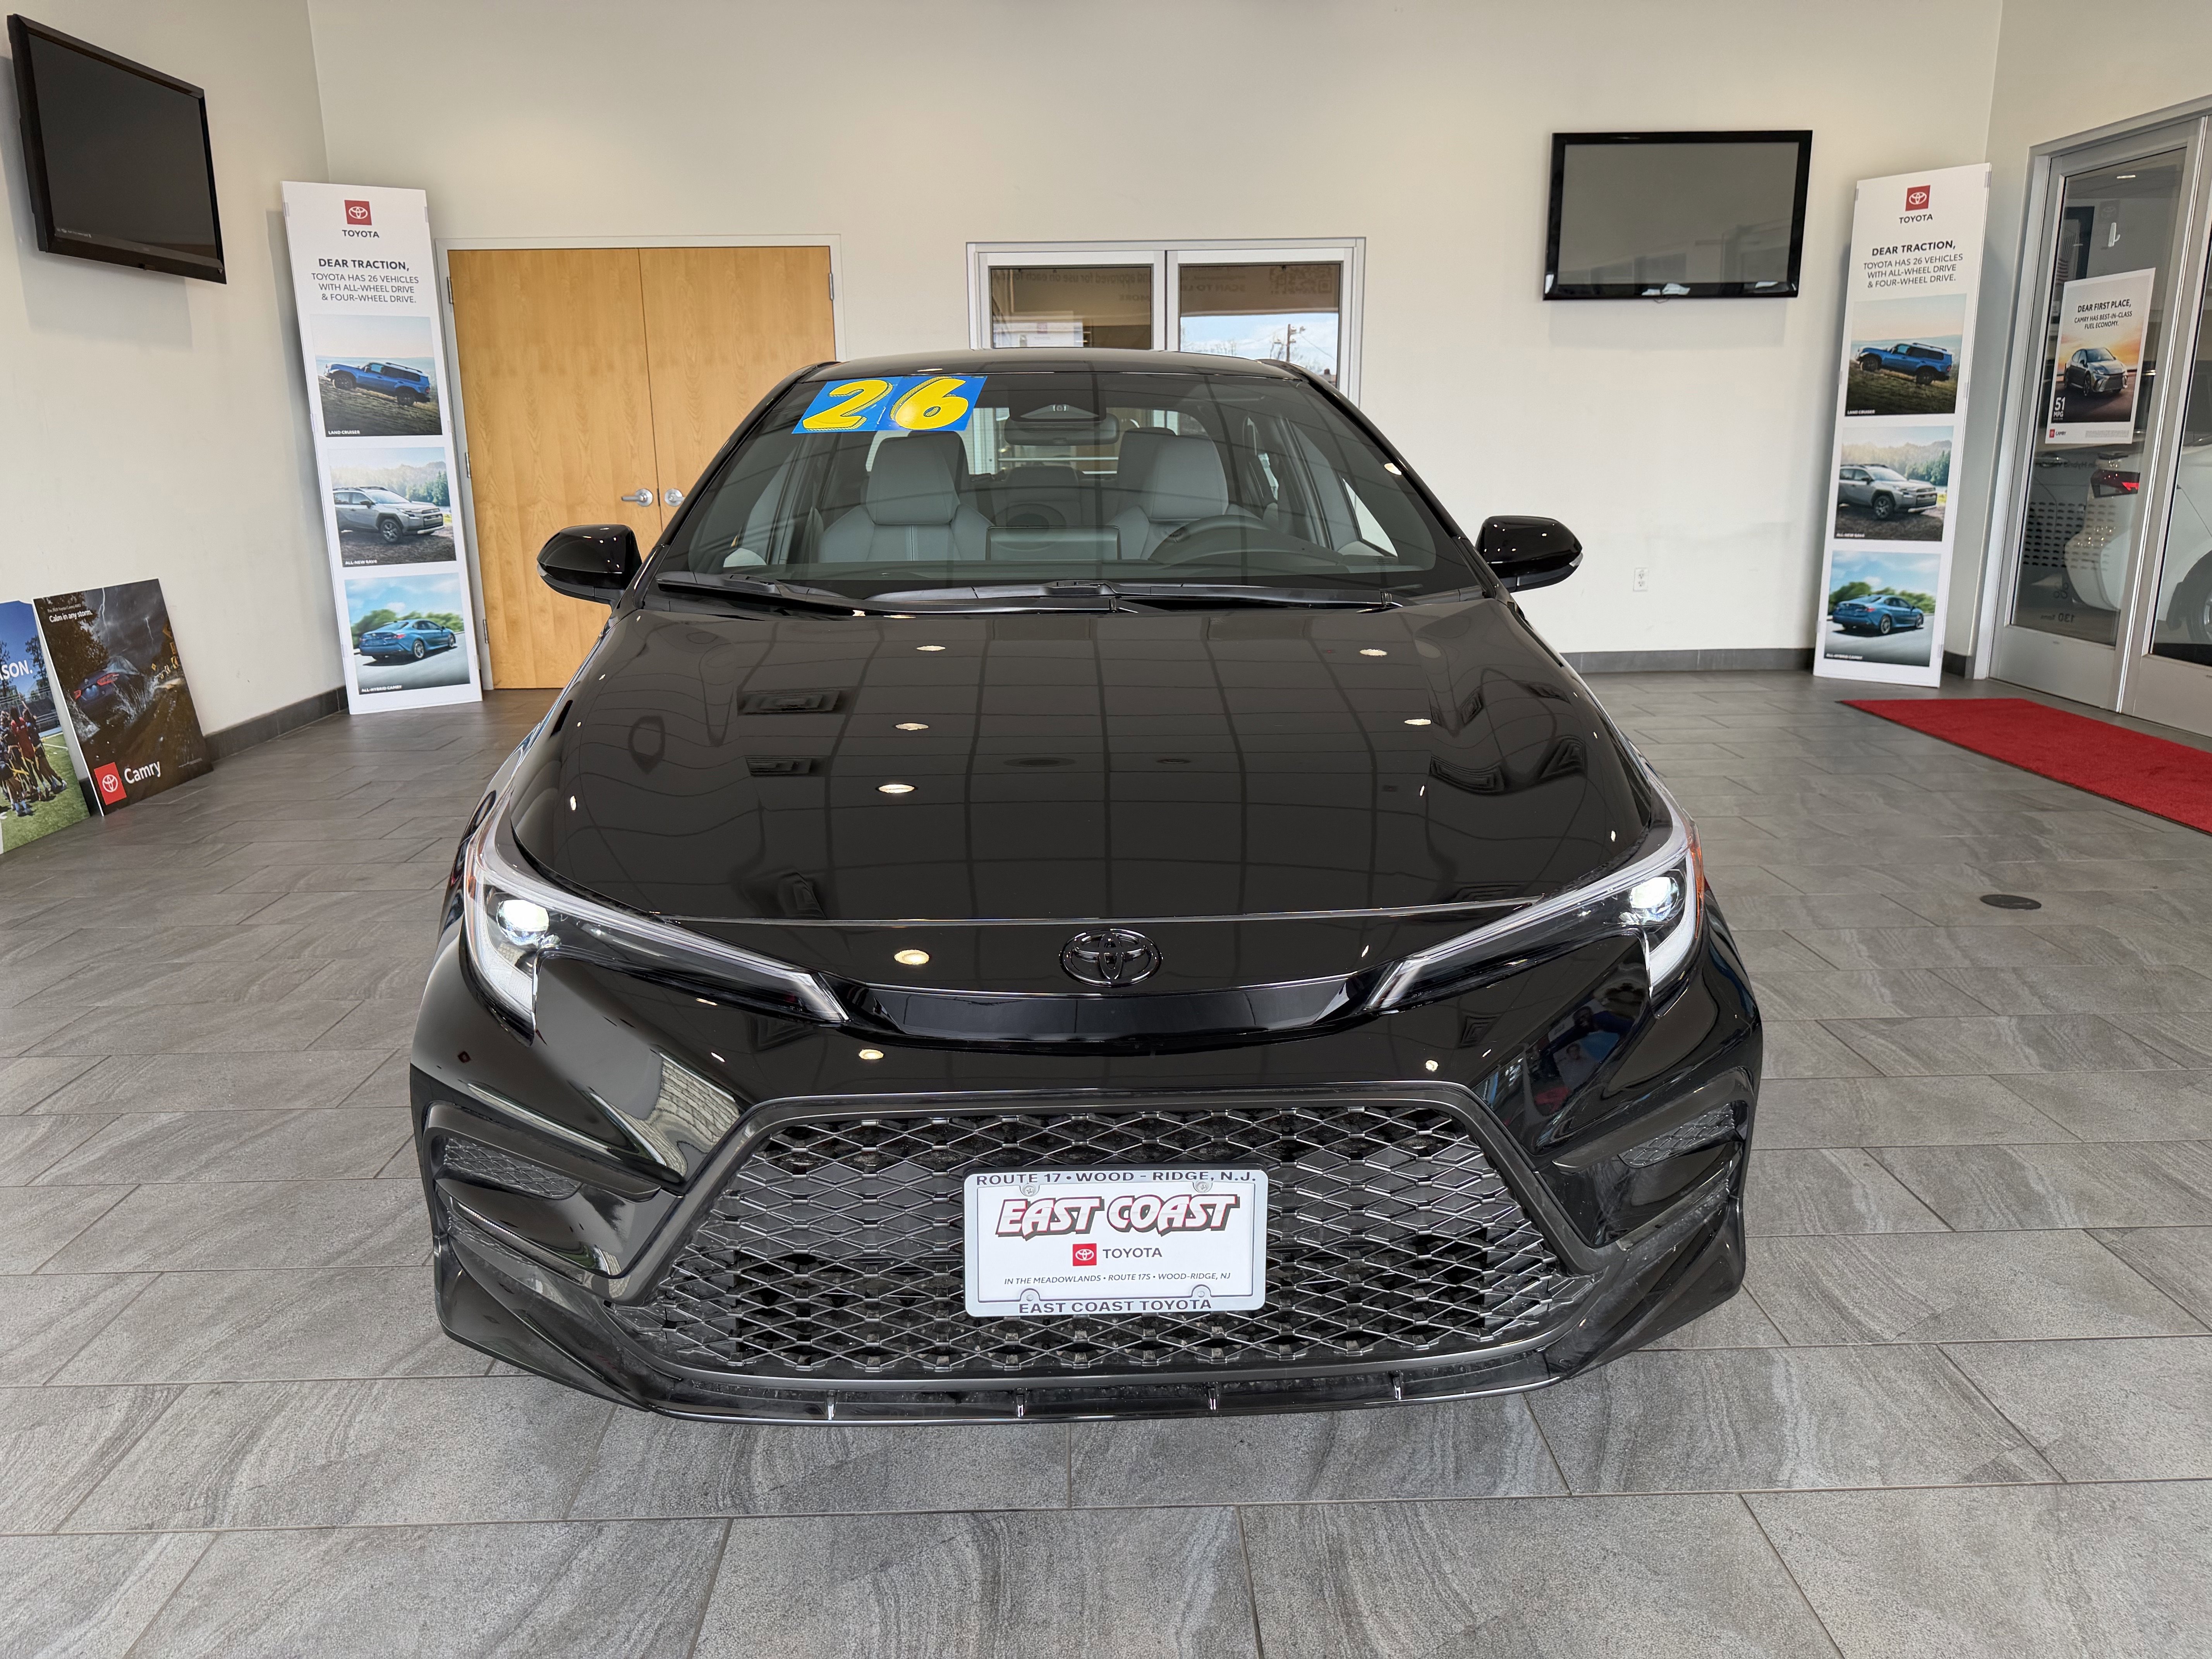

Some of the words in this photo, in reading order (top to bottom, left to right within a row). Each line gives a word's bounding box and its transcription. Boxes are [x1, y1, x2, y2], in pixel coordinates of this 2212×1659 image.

[1899, 214, 1933, 224] TOYOTA
[342, 230, 380, 238] TOYOTA
[1872, 246, 1898, 256] DEAR
[1901, 240, 1956, 253] TRACTION,
[319, 259, 349, 268] DEAR
[351, 260, 409, 271] TRACTION,
[1863, 261, 1892, 270] TOYOTA
[1895, 259, 1911, 267] HAS
[1925, 254, 1963, 263] VEHICLES
[1867, 270, 1886, 278] WITH
[1888, 266, 1931, 276] ALL-WHEEL
[1933, 264, 1956, 273] DRIVE
[311, 273, 345, 281] TOYOTA
[380, 275, 419, 283] VEHICLES
[1875, 277, 1927, 287] FOUR-WHEEL
[1930, 274, 1956, 283] DRIVE.
[343, 284, 389, 292] ALL-WHEEL
[330, 294, 388, 302] FOUR-WHEEL
[2078, 304, 2093, 313] DEAR
[2094, 302, 2110, 311] FIRST
[2111, 299, 2131, 308] PLACE,
[2100, 311, 2132, 321] BEST-IN-CLASS
[2095, 320, 2119, 328] ECONOMY.
[2055, 397, 2066, 411] 51
[49, 614, 63, 623] Calm
[124, 761, 161, 784] Camry
[977, 1173, 1038, 1185] ROUTE
[1044, 1173, 1061, 1182] 17
[1076, 1172, 1134, 1182] WOOD
[1153, 1171, 1214, 1181] RIDGE,
[1221, 1171, 1256, 1181] N.J.
[995, 1196, 1104, 1241] EAST
[1107, 1194, 1240, 1237] COAST
[1103, 1247, 1163, 1259] TOYOTA
[1034, 1275, 1101, 1284] MEADOWLANDS
[1019, 1303, 1066, 1313] EAST
[1072, 1301, 1134, 1312] COAST
[1139, 1299, 1212, 1310] TOYOTA
